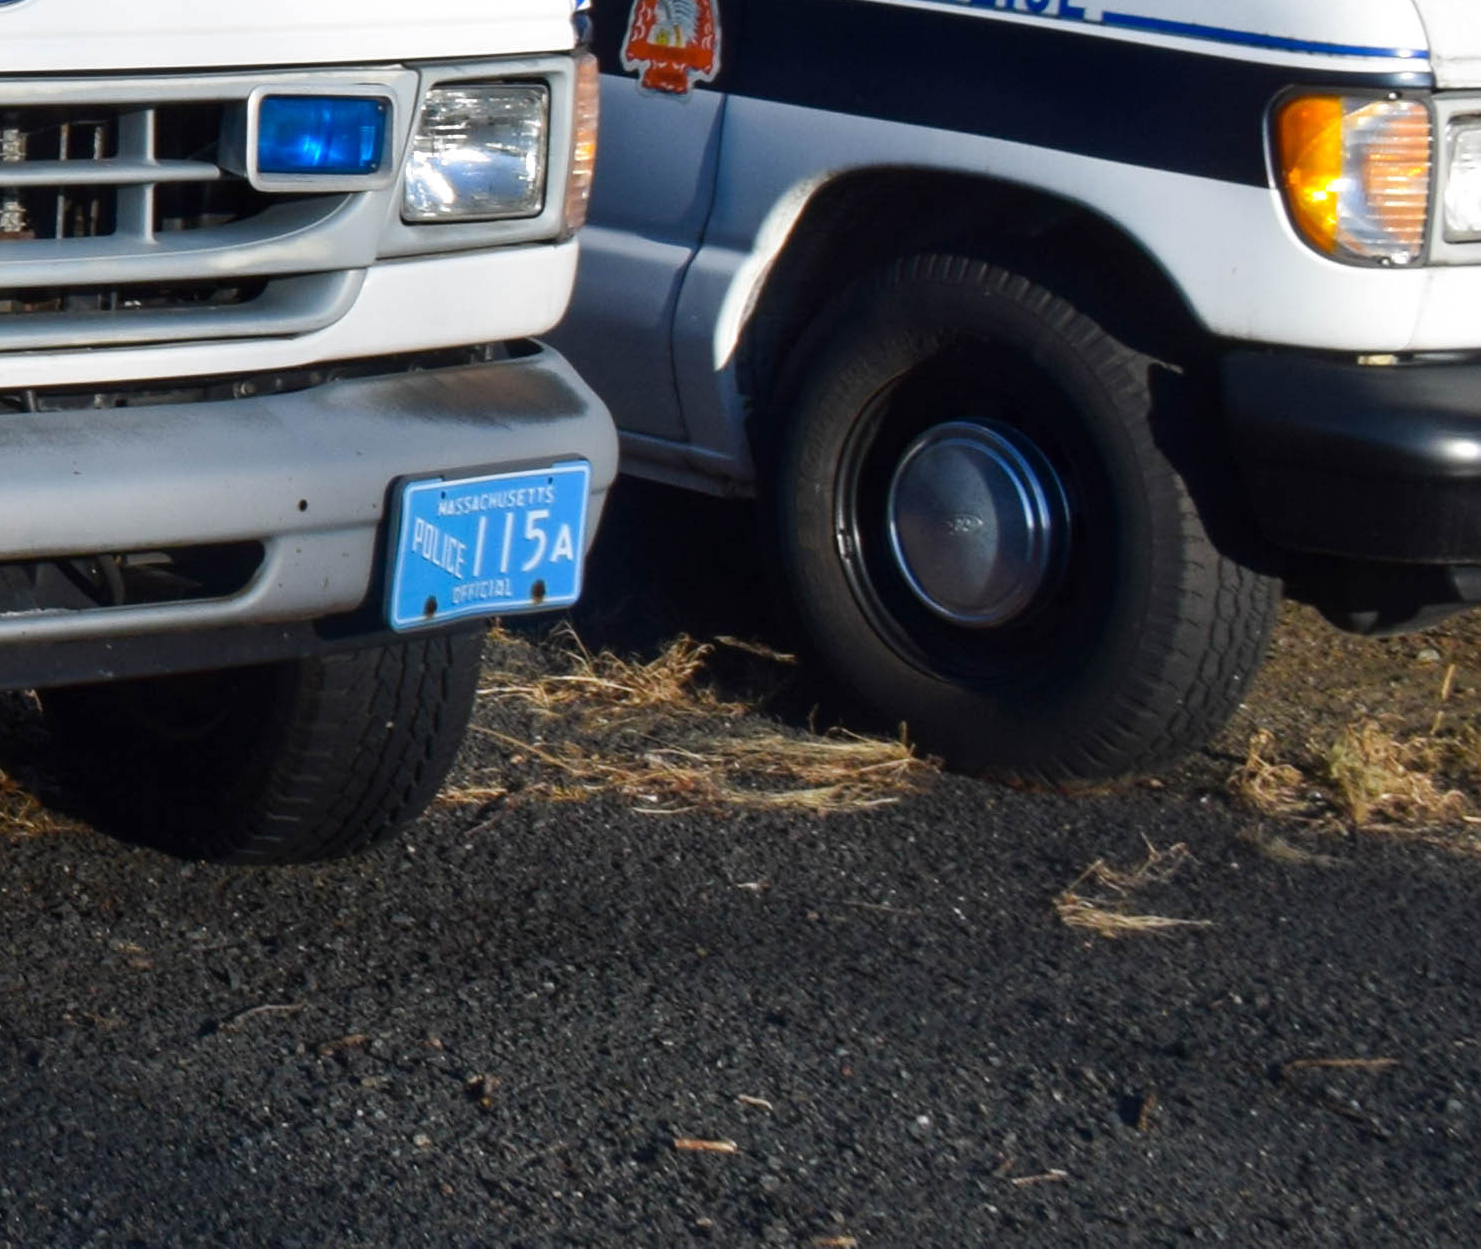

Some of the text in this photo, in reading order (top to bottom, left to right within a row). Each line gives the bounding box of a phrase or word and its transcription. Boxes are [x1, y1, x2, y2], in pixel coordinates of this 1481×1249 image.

[437, 485, 557, 518] MASSACHUSETTS
[411, 516, 467, 580] POLICE
[451, 577, 514, 605] OFFICIAL
